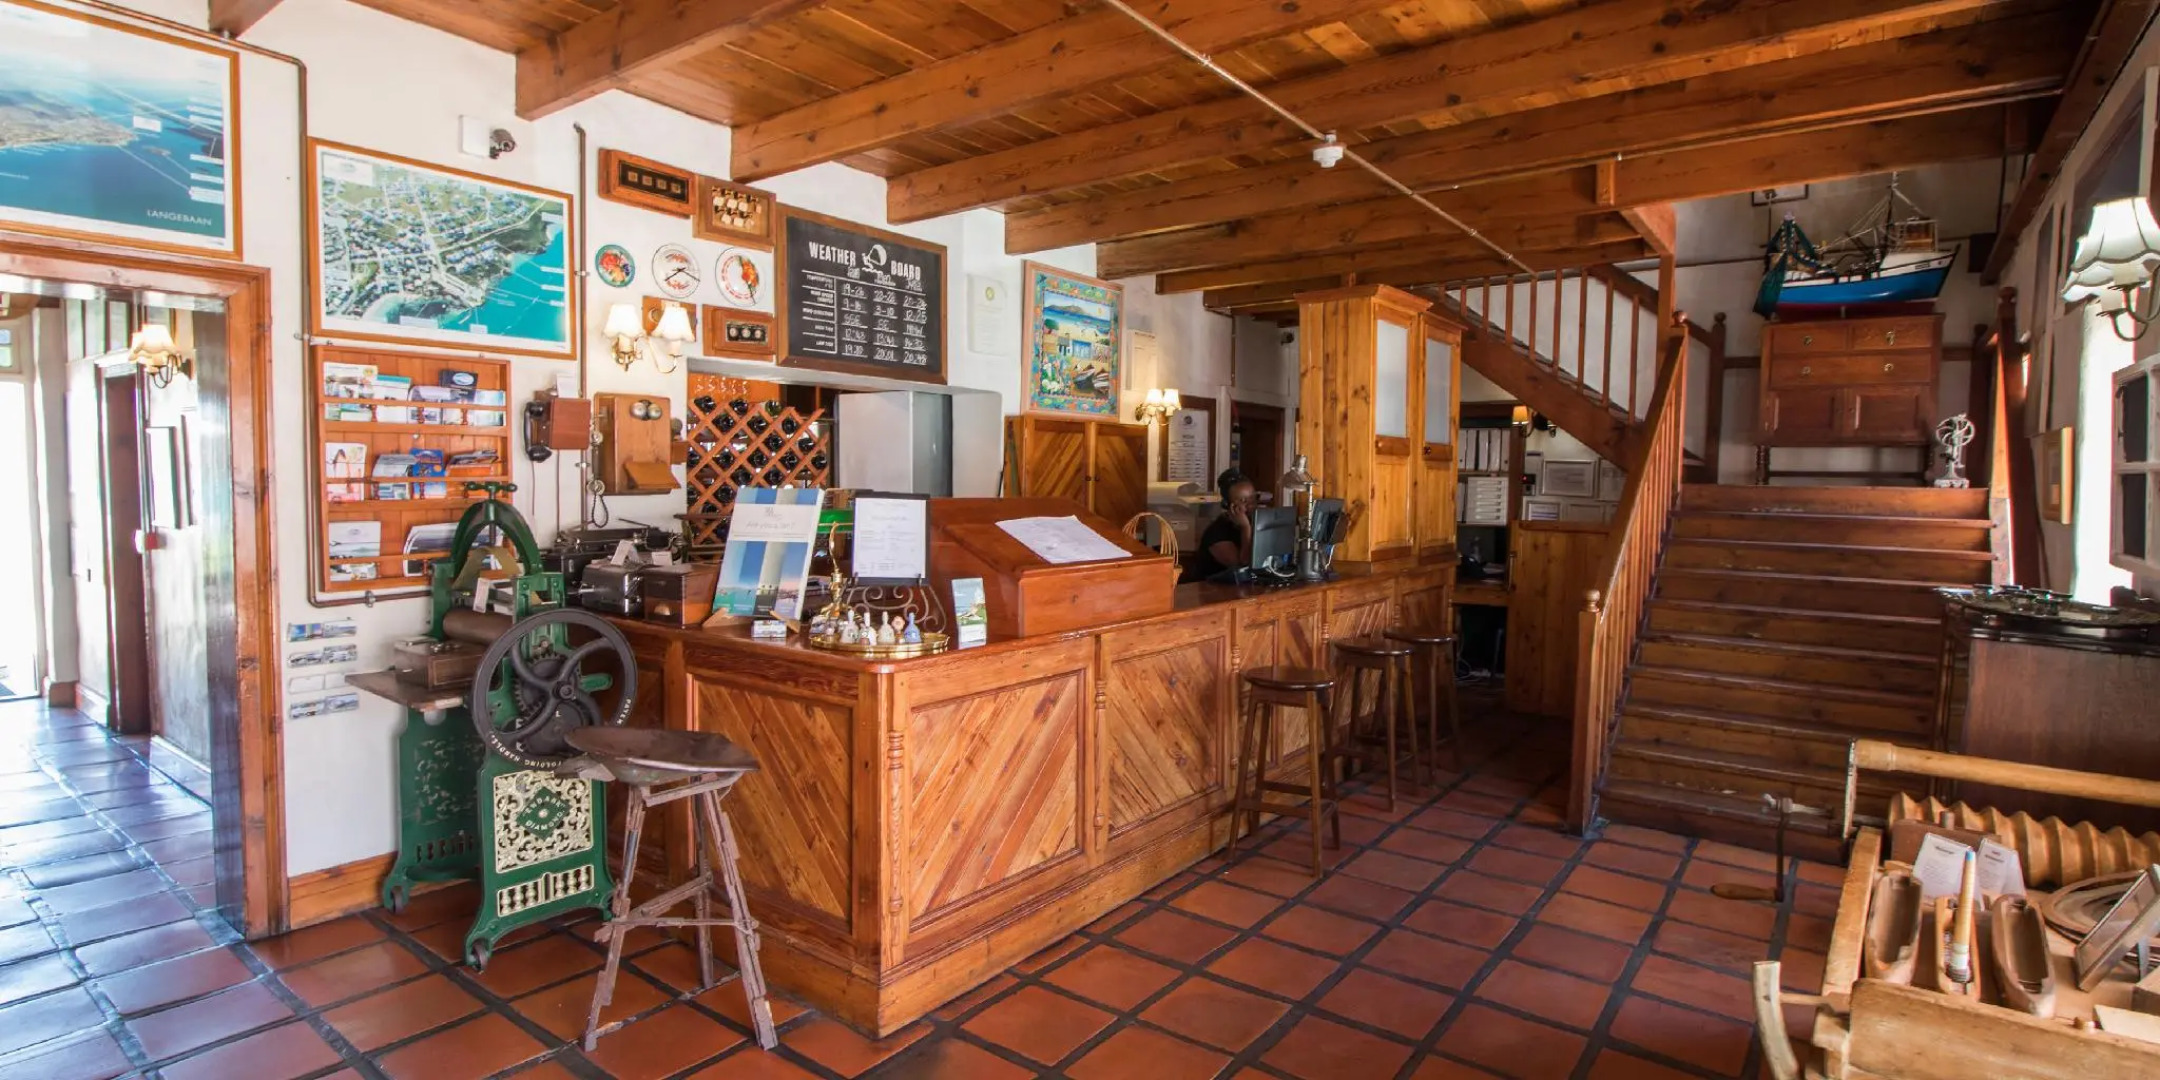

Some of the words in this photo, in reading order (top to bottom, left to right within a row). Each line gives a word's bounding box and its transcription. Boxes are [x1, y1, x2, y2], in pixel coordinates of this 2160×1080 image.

[147, 209, 212, 226] LANGEBAAN
[809, 241, 856, 266] WEATHER
[890, 260, 922, 281] BOARD
